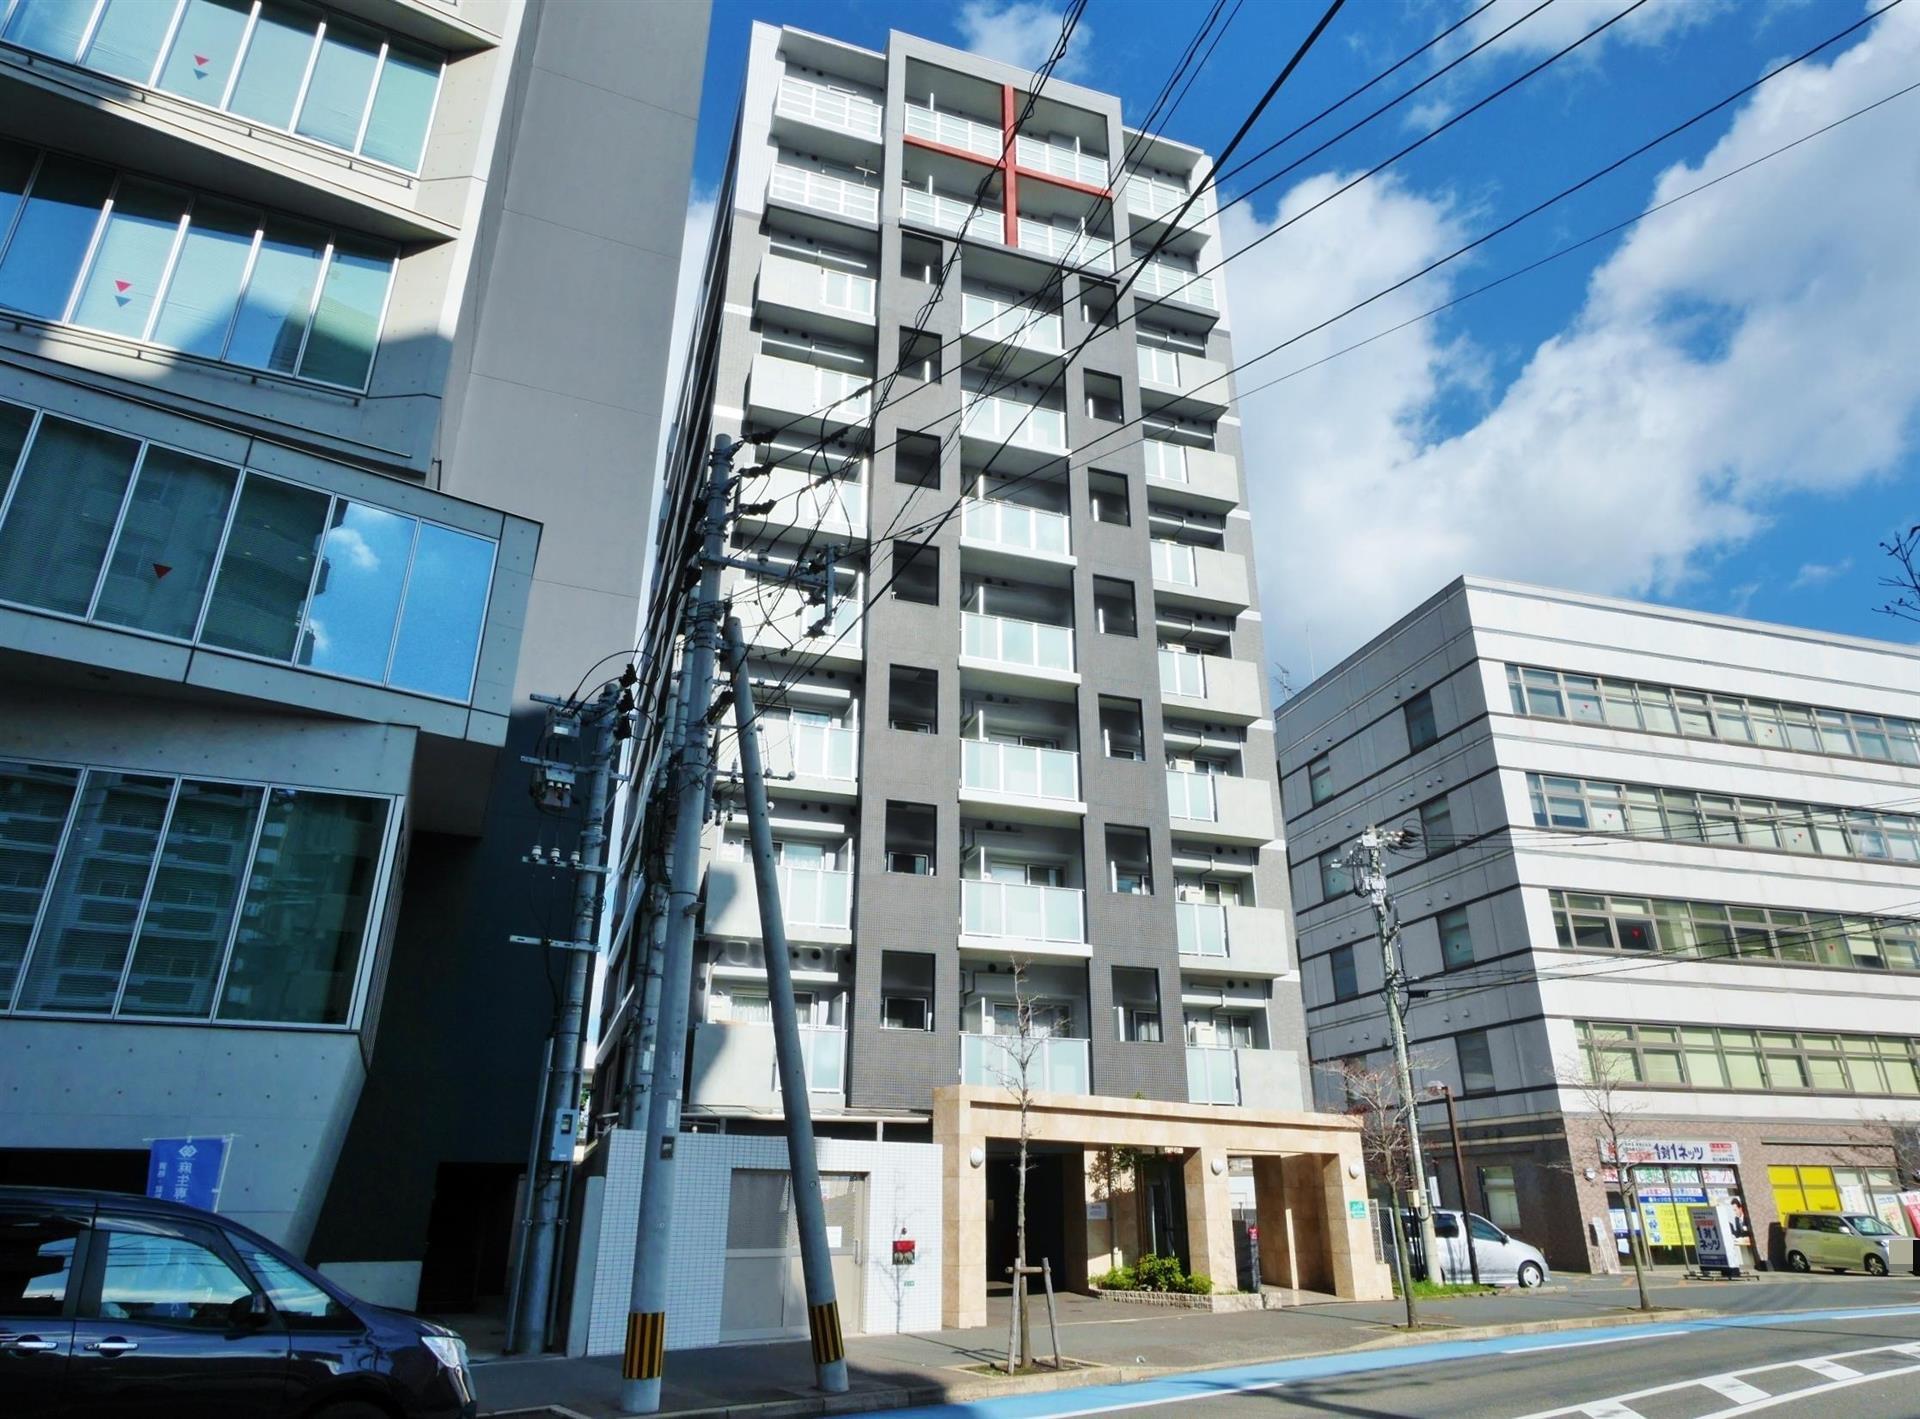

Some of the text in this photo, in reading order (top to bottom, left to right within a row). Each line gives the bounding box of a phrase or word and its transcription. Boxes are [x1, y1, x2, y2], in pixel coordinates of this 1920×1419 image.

[1653, 1143, 1704, 1160] 1対1ネッツ
[1699, 1239, 1721, 1251] ネッツ
